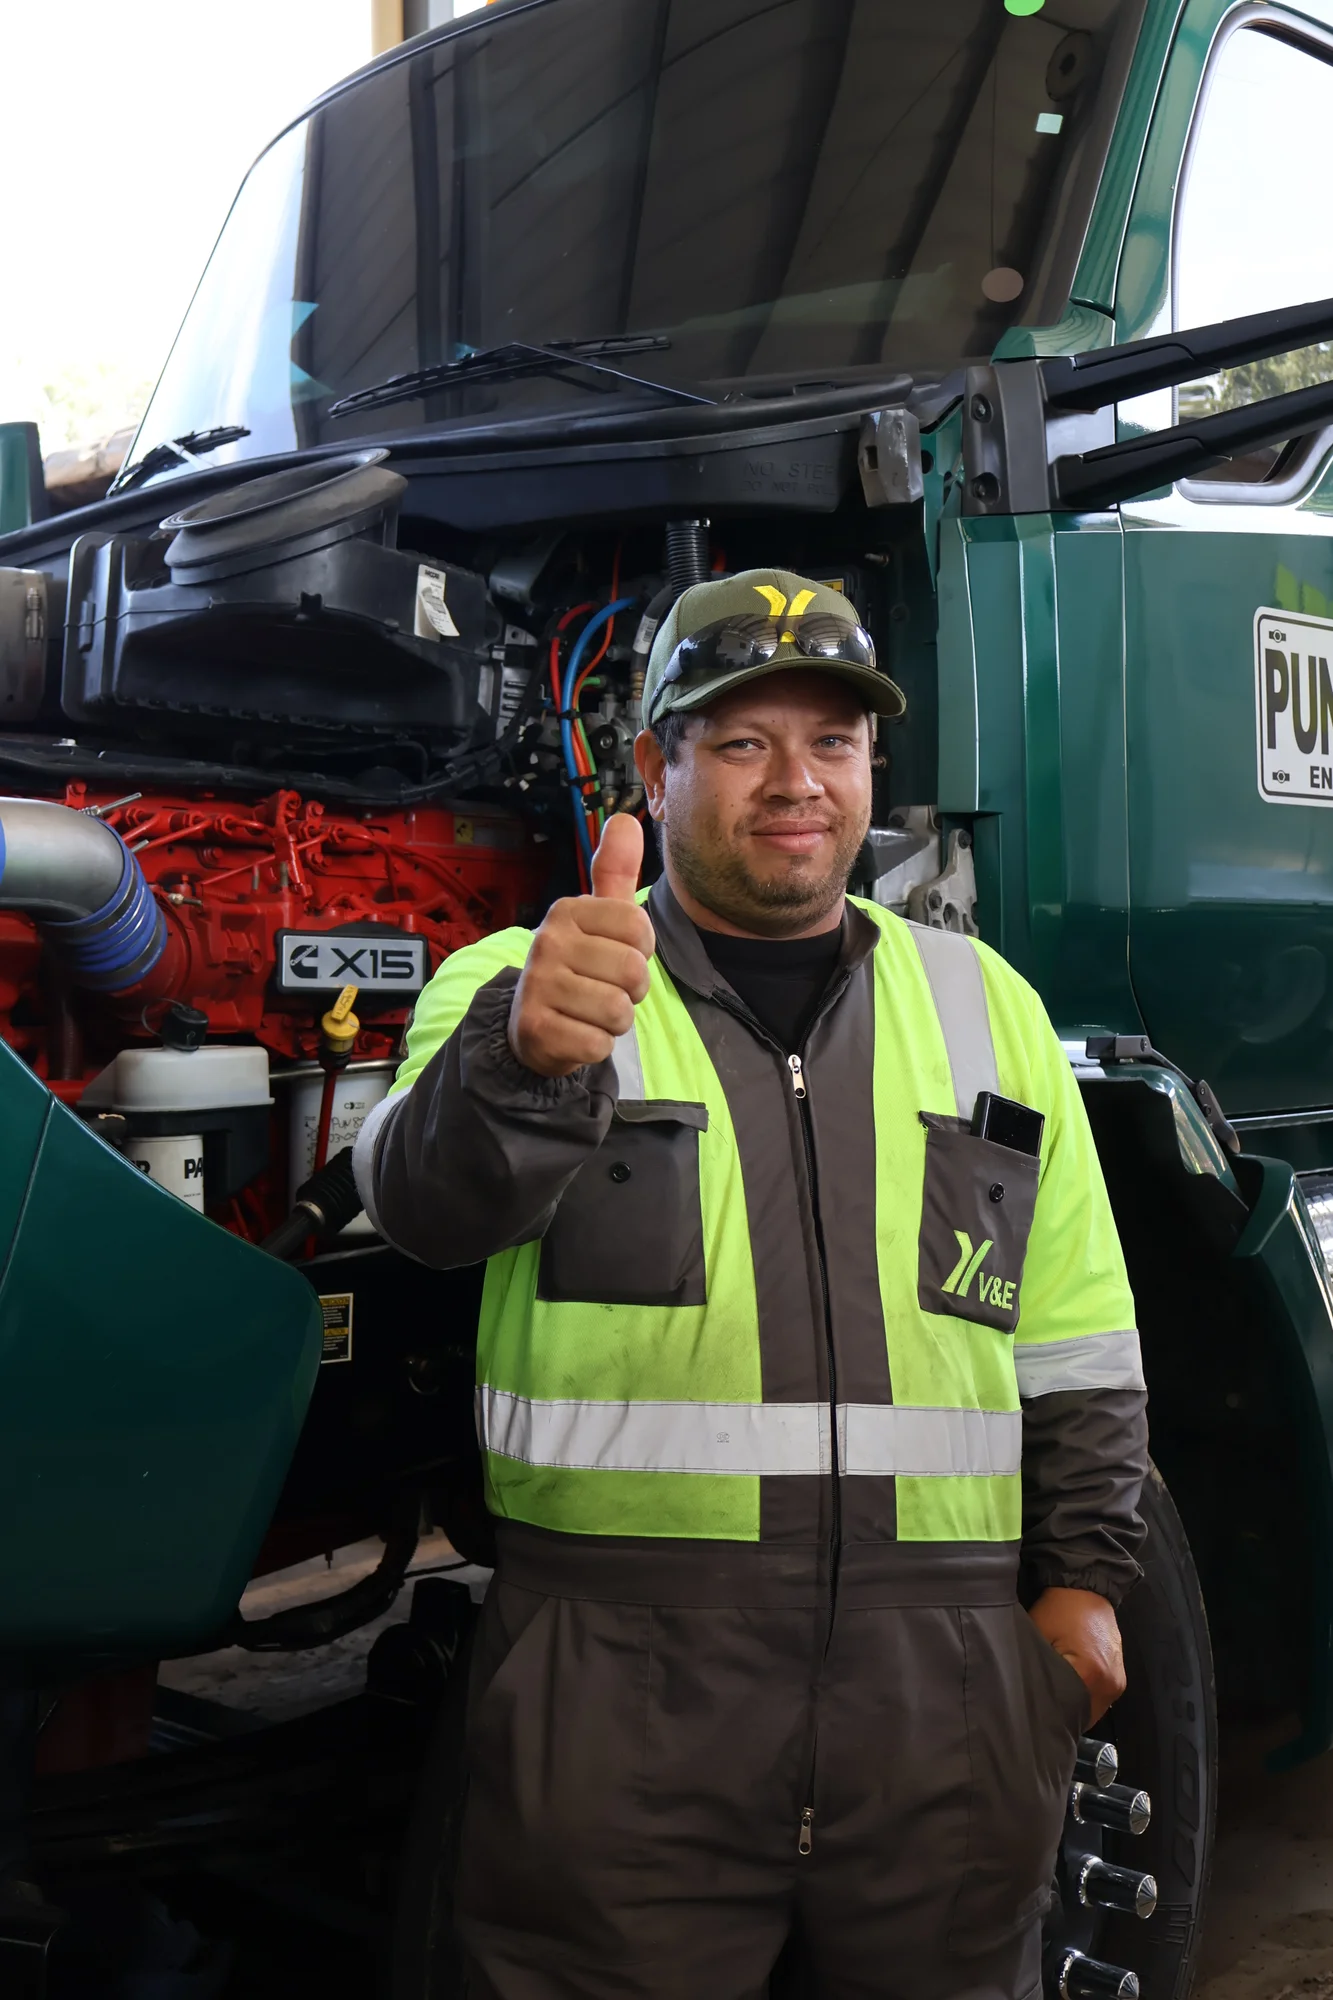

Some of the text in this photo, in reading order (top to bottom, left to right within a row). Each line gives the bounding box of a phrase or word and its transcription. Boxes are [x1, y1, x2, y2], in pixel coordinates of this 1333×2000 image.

[743, 461, 775, 478] NO
[1310, 765, 1333, 789] EN
[329, 947, 414, 979] X15
[979, 1271, 1017, 1311] V&E
